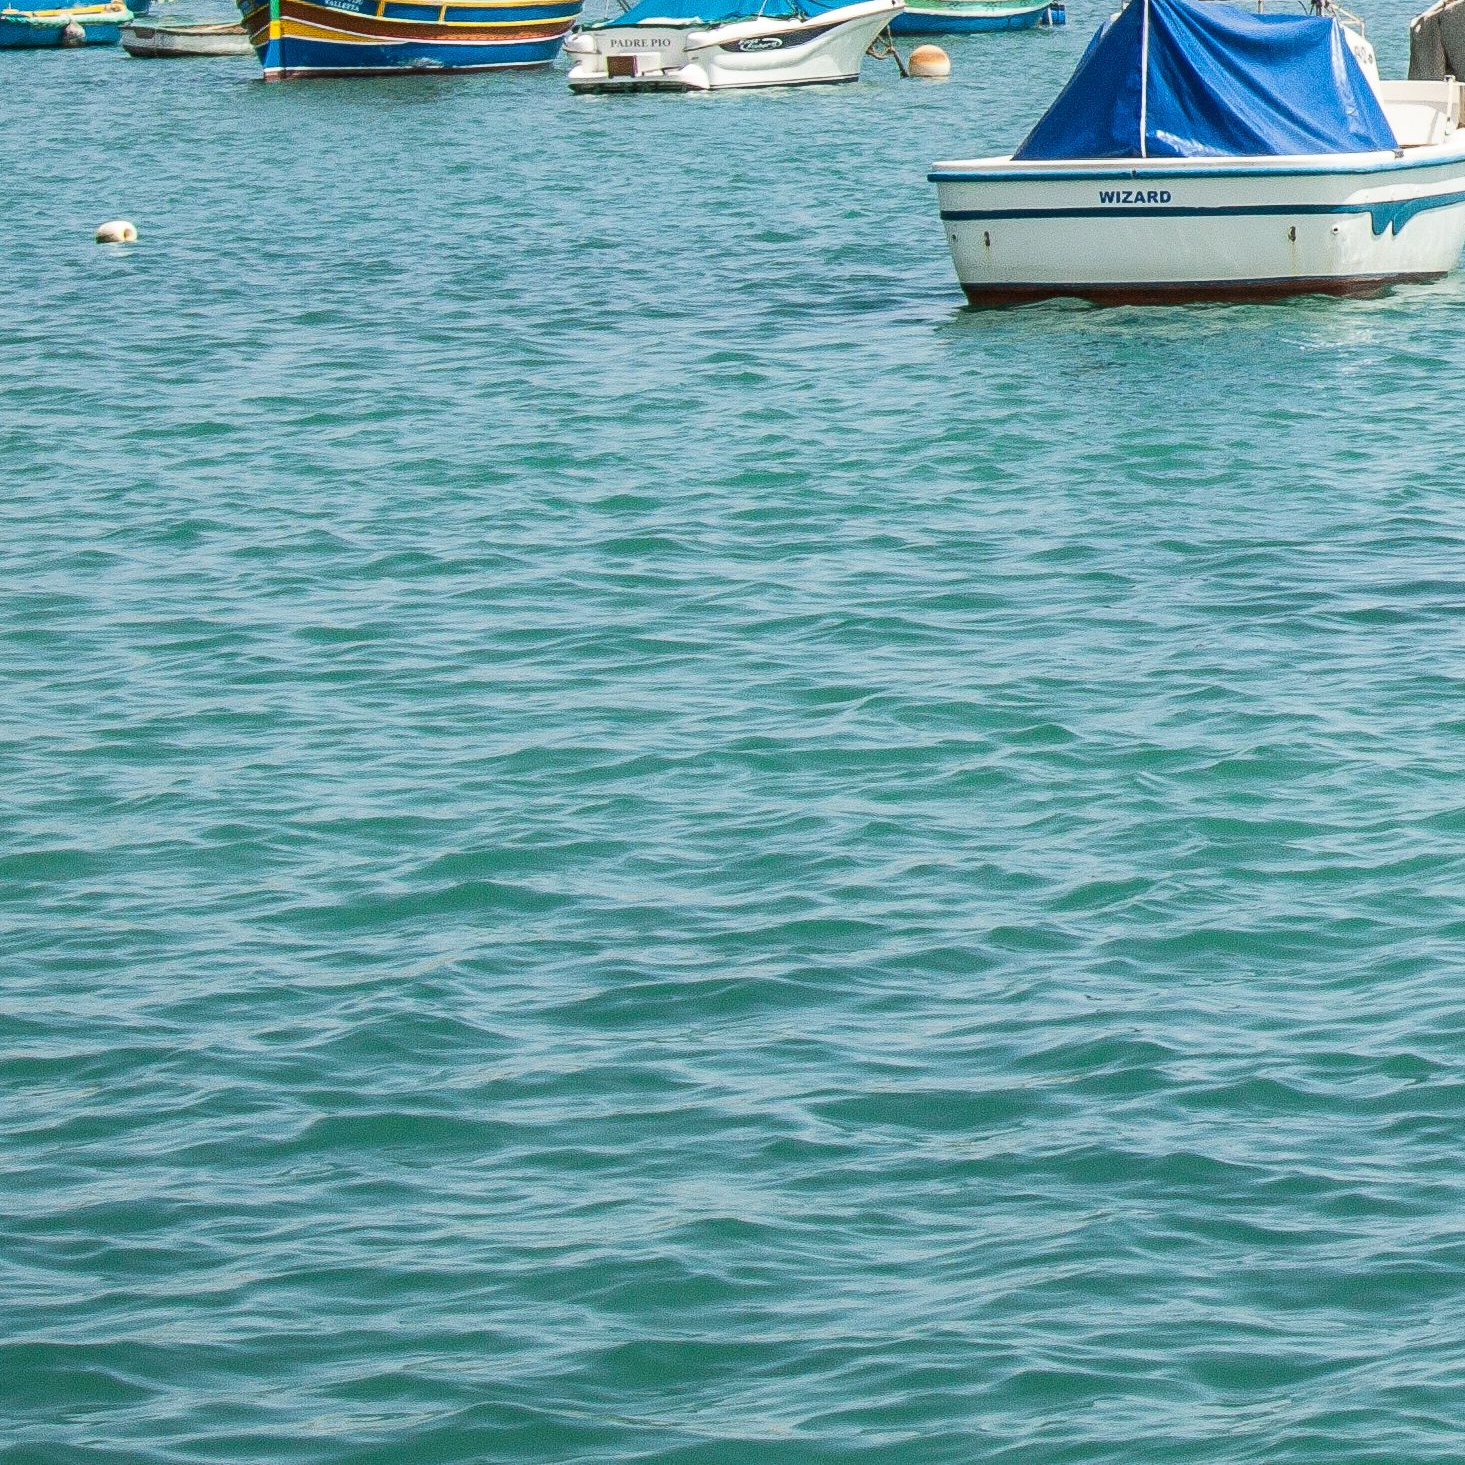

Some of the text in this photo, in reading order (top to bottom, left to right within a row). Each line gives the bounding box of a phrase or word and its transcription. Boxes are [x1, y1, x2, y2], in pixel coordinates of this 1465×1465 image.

[610, 38, 671, 48] PADRE PIO
[1099, 190, 1172, 204] WIZARD
